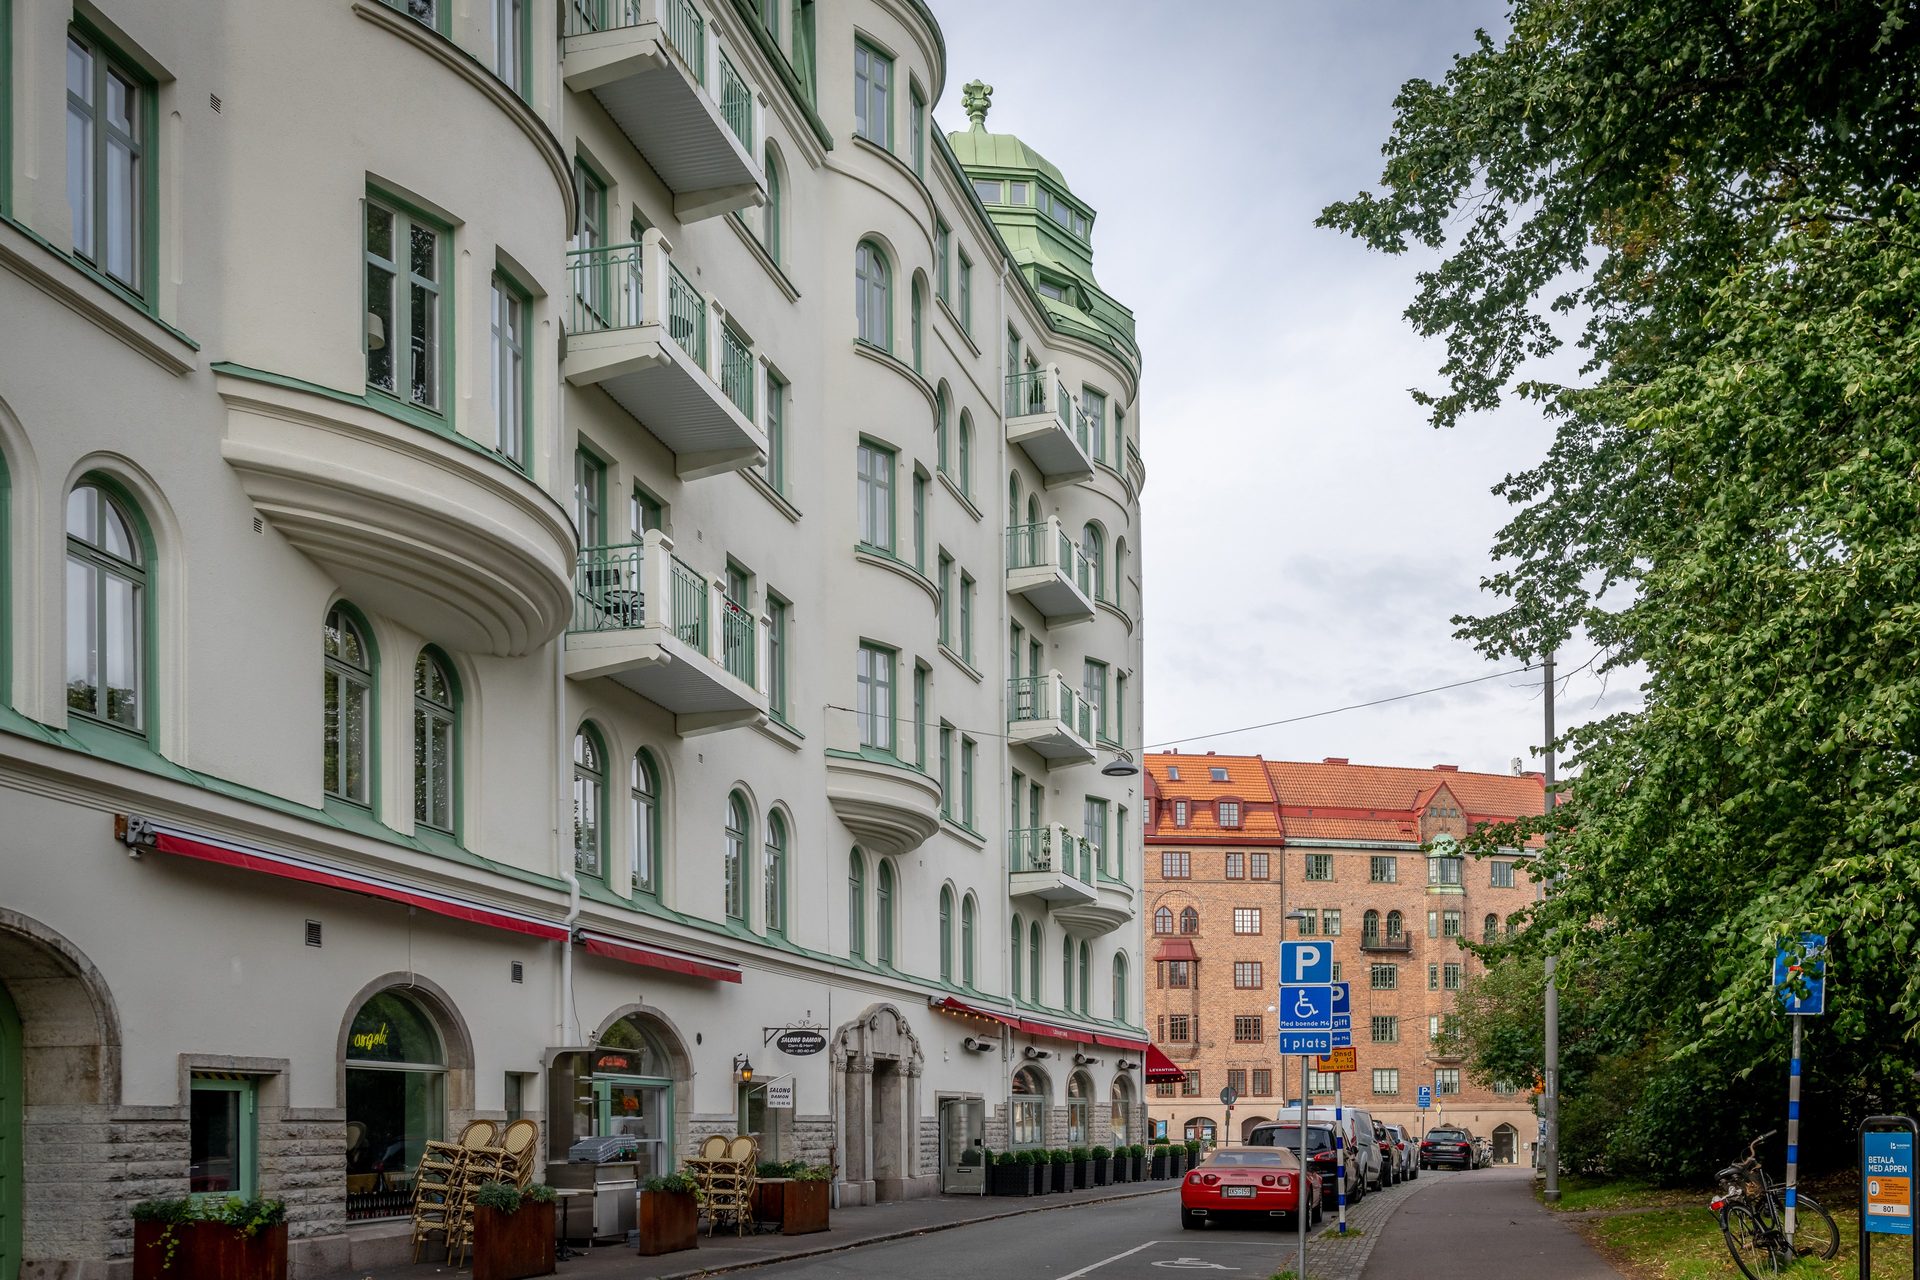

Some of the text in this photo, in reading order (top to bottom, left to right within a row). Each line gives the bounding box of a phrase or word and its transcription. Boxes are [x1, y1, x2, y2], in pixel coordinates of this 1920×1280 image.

[1296, 946, 1321, 981] P
[1332, 1019, 1348, 1028] gift
[1283, 1038, 1327, 1050] 1 plats
[1421, 1087, 1428, 1096] P
[1868, 1156, 1895, 1164] BETALA
[1868, 1164, 1908, 1173] MED APPEN
